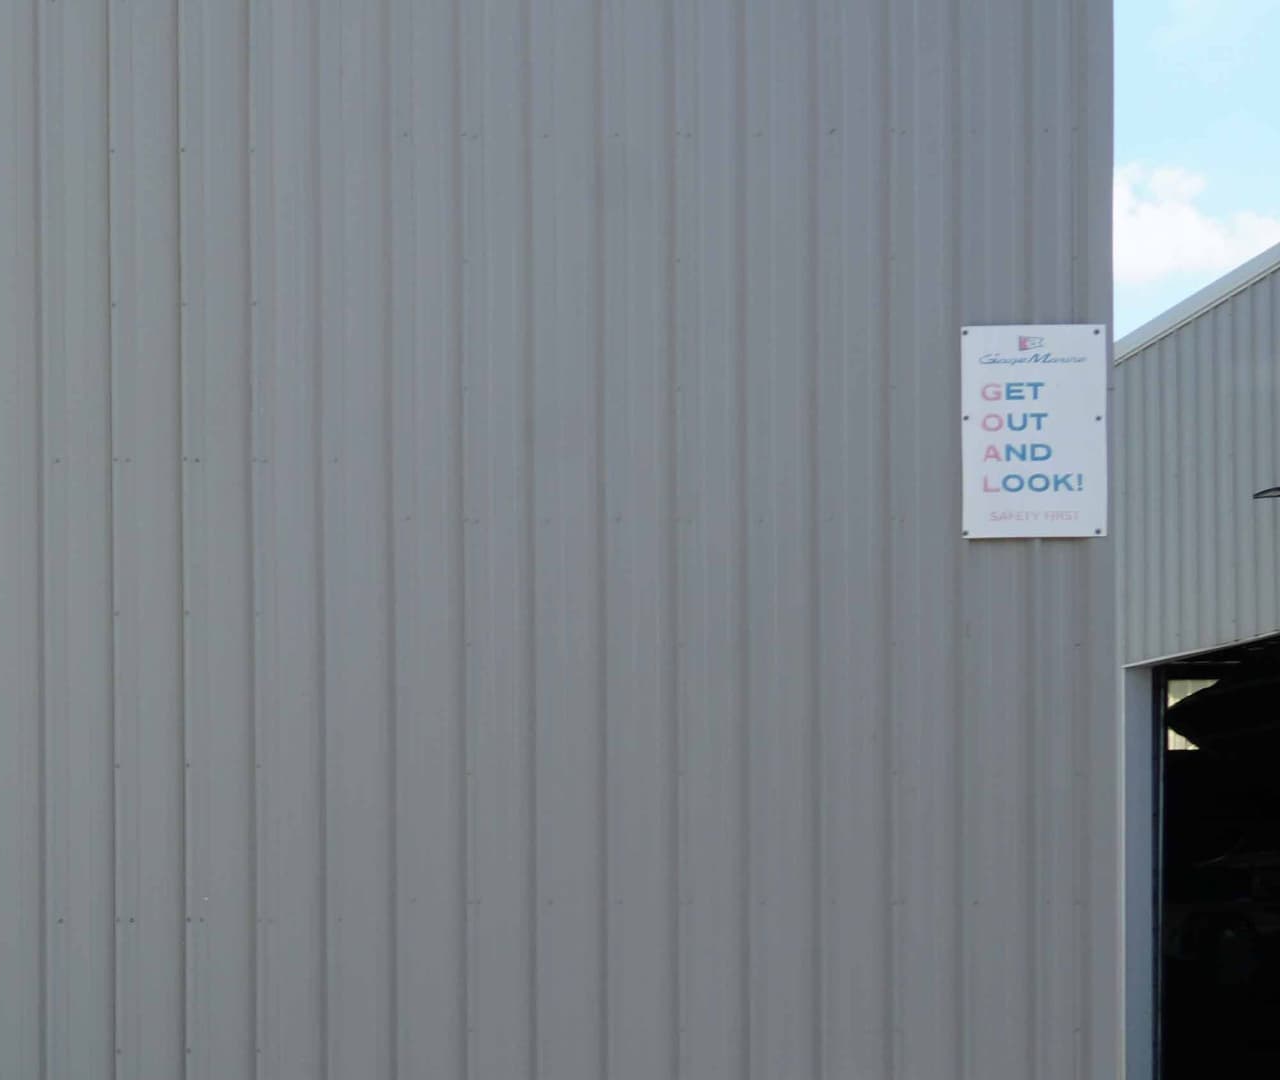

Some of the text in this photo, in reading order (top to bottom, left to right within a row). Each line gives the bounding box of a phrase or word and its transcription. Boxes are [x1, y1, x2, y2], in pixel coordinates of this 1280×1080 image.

[980, 382, 1045, 402] GET
[981, 413, 1048, 432] OUT
[983, 444, 1053, 462] AND
[983, 473, 1084, 493] LOOK!
